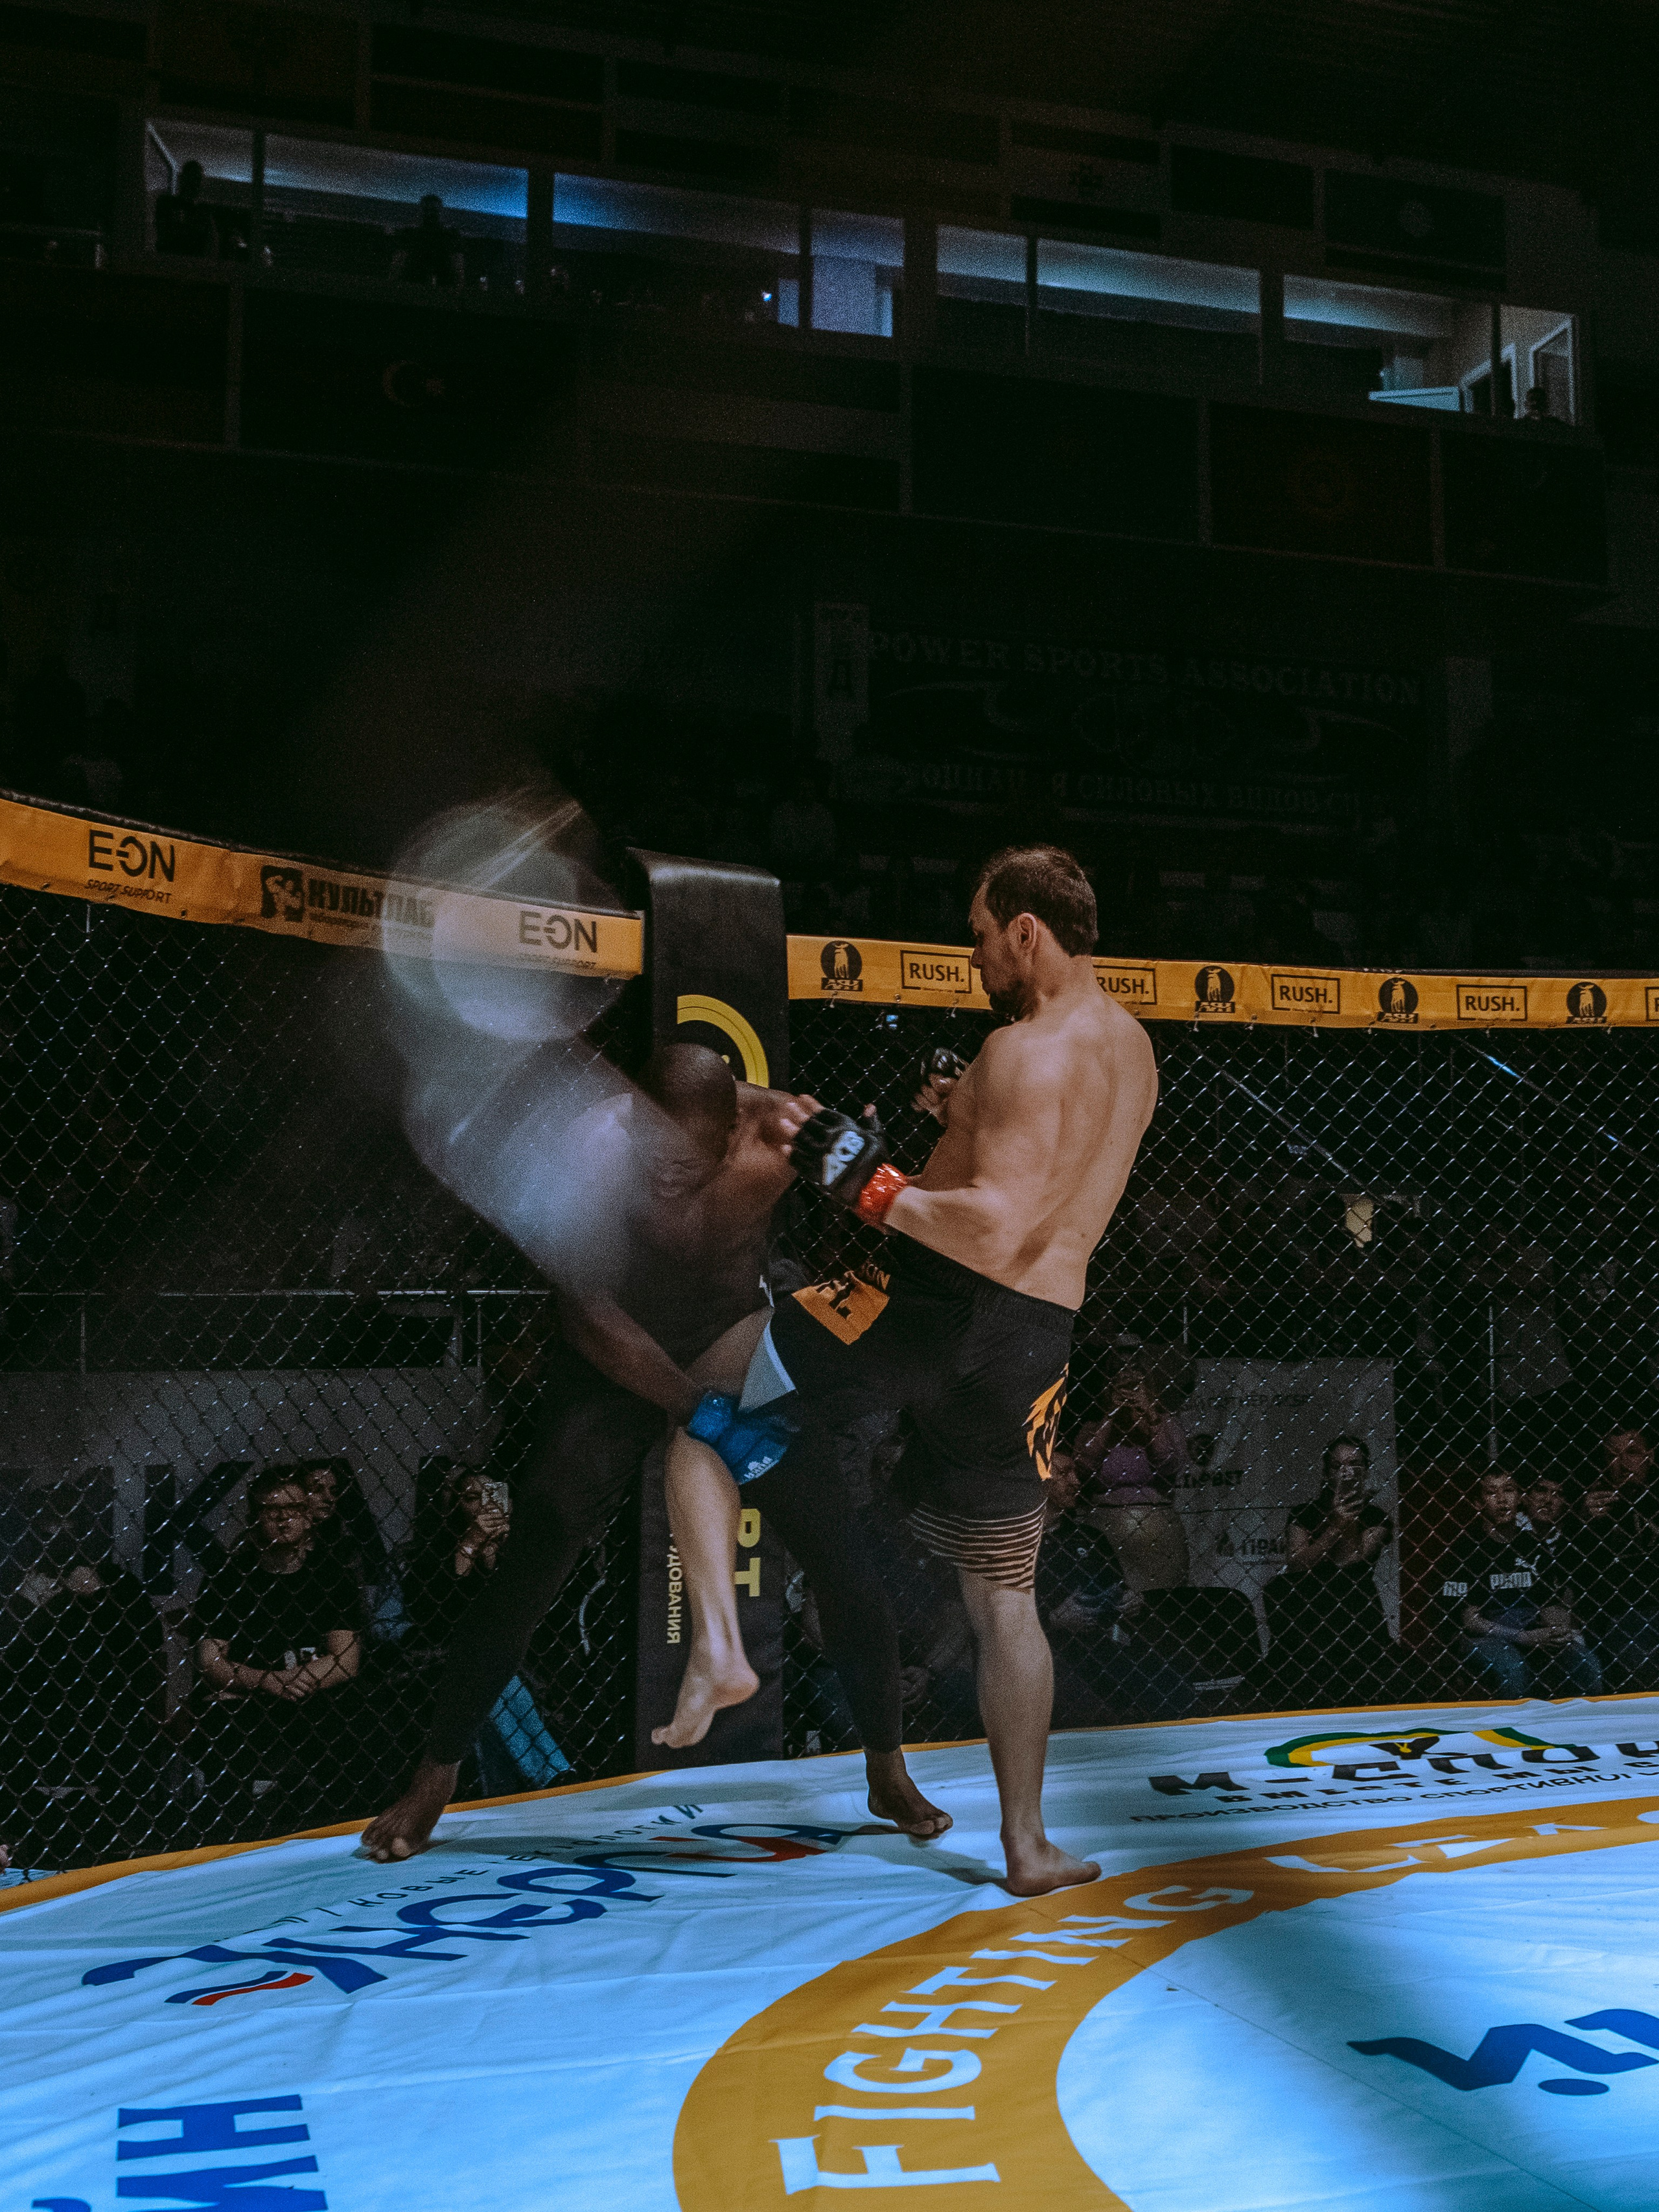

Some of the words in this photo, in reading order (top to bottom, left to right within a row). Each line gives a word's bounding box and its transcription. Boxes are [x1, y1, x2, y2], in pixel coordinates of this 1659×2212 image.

[867, 631, 1011, 669] POWER
[1024, 644, 1167, 684] SPORTS
[1186, 657, 1421, 704] ASSOCIATION
[84, 879, 120, 893] SPORT
[121, 885, 172, 903] SUPPORT
[909, 962, 964, 983] RUSH.
[1096, 976, 1150, 994] RUSH.
[1280, 985, 1334, 1003] RUSH.
[1465, 995, 1520, 1012] RUSH.
[1130, 1795, 1411, 1822] ПРОИЗВОДСТВО
[347, 1868, 489, 1908] НОВЫЕ
[769, 1885, 1255, 2196] FIGHTING
